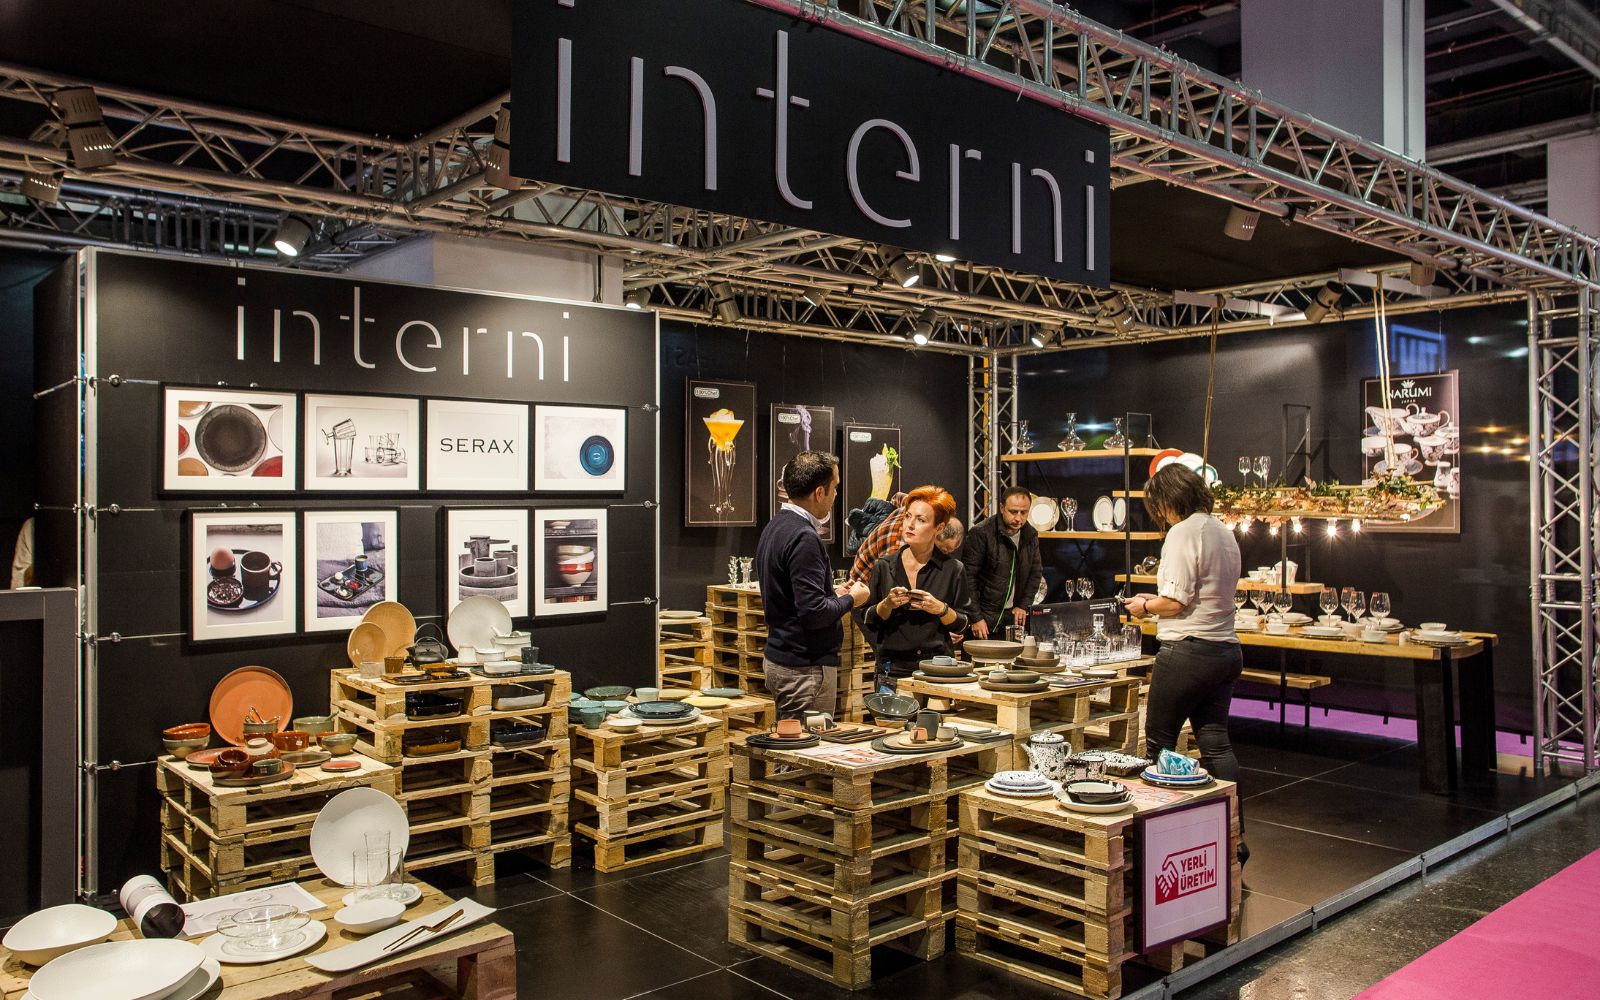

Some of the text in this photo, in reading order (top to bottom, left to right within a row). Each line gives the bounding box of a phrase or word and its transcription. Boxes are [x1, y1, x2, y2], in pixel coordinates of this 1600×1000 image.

[556, 0, 1095, 271] interni
[237, 277, 569, 382] interni
[440, 438, 514, 454] SERAX
[1181, 850, 1207, 872] YERLİ
[1180, 868, 1214, 891] ÜRETİM
